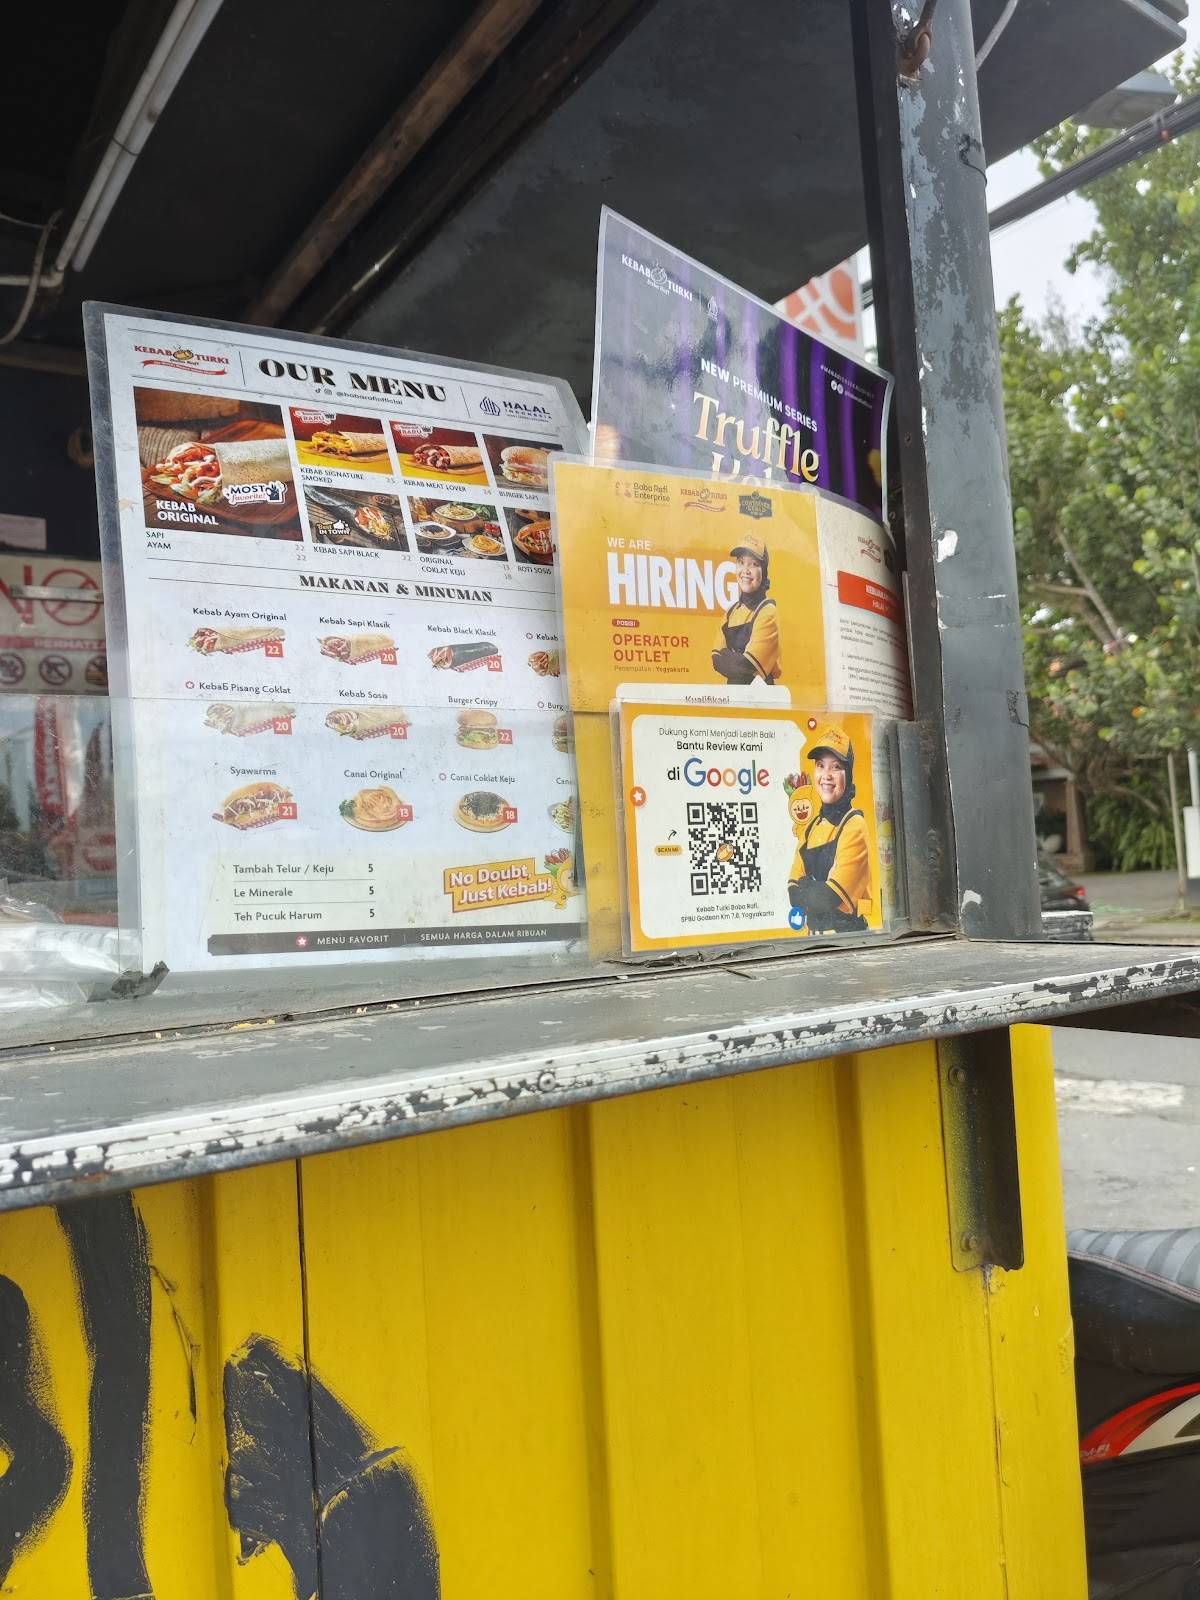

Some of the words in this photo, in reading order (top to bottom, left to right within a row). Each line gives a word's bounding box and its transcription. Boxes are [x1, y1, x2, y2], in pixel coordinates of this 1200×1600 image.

[621, 254, 650, 278] KEBAB
[667, 280, 692, 301] TURKI
[134, 345, 172, 356] KEBAB
[195, 354, 230, 364] TURKI
[258, 358, 336, 387] OUR
[348, 372, 447, 402] MENU
[700, 358, 730, 382] NEW
[733, 376, 783, 412] PREMIUM
[785, 404, 818, 432] SERIES
[502, 401, 550, 415] HALAL
[692, 392, 820, 482] Truffle
[300, 467, 324, 475] KEBAB
[325, 470, 364, 480] SIGNATURE
[301, 475, 333, 484] SMOKED
[230, 485, 266, 494] MOST
[404, 480, 423, 488] KEBAB
[426, 482, 444, 490] MEAT
[446, 484, 466, 492] LOVER
[633, 482, 653, 492] Baba
[654, 484, 668, 494] Rafi
[232, 492, 266, 501] favorite!
[499, 491, 524, 499] BURGER
[634, 492, 671, 502] Enterprise
[156, 500, 196, 512] KEBAB
[157, 511, 219, 526] ORIGINAL
[146, 531, 164, 539] SAPI
[147, 541, 172, 550] AYAM
[607, 536, 625, 548] WE
[630, 538, 651, 550] ARE
[314, 546, 338, 554] KEBAB
[338, 548, 355, 556] SAPI
[356, 550, 380, 559] BLACK
[420, 556, 454, 566] ORIGINAL
[422, 566, 448, 575] COKLAT
[450, 568, 466, 576] KEJU
[606, 552, 740, 611] HIRING
[299, 574, 390, 594] MAKANAN
[396, 583, 410, 595] &
[414, 585, 492, 602] MINUMAN
[192, 607, 222, 617] Kebab
[224, 610, 250, 620] Ayam
[252, 612, 288, 622] Original
[319, 616, 346, 626] Kebab
[348, 618, 366, 628] Sapi
[367, 620, 391, 629] Klasik
[427, 624, 452, 634] Kebab
[453, 626, 473, 636] Black
[536, 632, 559, 642] Kebab
[612, 634, 690, 648] OPERATOR
[267, 646, 280, 656] 22
[614, 650, 670, 662] OUTLET
[382, 653, 394, 662] 20
[488, 660, 500, 670] 20
[656, 666, 690, 674] Yogyakarta
[199, 682, 229, 691] Kebab
[231, 684, 260, 695] Pisang
[262, 686, 291, 694] Coklat
[339, 690, 366, 698] Kebab
[448, 696, 473, 706] Burger
[474, 698, 498, 707] Crispy
[548, 702, 564, 710] Burg
[686, 696, 730, 705] Kualifikasi
[276, 722, 288, 731] 20
[392, 726, 404, 736] 20
[499, 732, 510, 741] 22
[658, 728, 688, 738] Dukung
[689, 728, 708, 737] Kami
[710, 730, 738, 739] Menjadi
[740, 730, 758, 738] Lebih
[676, 741, 704, 750] Bantu
[706, 742, 738, 751] Review
[740, 742, 764, 752] Kami
[230, 766, 277, 776] Syawarma
[344, 770, 368, 778] Canai
[370, 770, 403, 780] Original
[668, 766, 680, 781] di
[684, 757, 770, 795] Google
[450, 774, 472, 782] Canai
[474, 774, 498, 782] Coklat
[500, 776, 516, 784] Keju
[282, 806, 294, 816] 21
[400, 808, 410, 818] 13
[506, 811, 515, 820] 18
[233, 864, 274, 874] Tambah
[276, 864, 302, 873] Telur
[313, 864, 334, 876] Keju
[368, 863, 374, 873] 5
[450, 871, 474, 888] No
[477, 864, 532, 884] Doubt,
[234, 888, 246, 898] Le
[249, 888, 294, 897] Minerale
[369, 886, 374, 896] 5
[459, 888, 494, 905] Just
[498, 878, 554, 898] Kebab!
[696, 905, 716, 913] Kebab
[716, 904, 730, 912] Turki
[234, 912, 252, 922] Teh
[256, 911, 286, 921] Pucuk
[290, 911, 322, 920] Harum
[370, 908, 375, 918] 5
[698, 914, 720, 922] Godean
[742, 910, 774, 920] Yogyakarta
[317, 936, 346, 945] MENU
[350, 934, 390, 944] FAVORIT
[420, 933, 450, 941] SEMUA
[453, 932, 482, 940] HARGA
[486, 930, 514, 938] DALAM
[516, 930, 547, 938] RIBUAN
